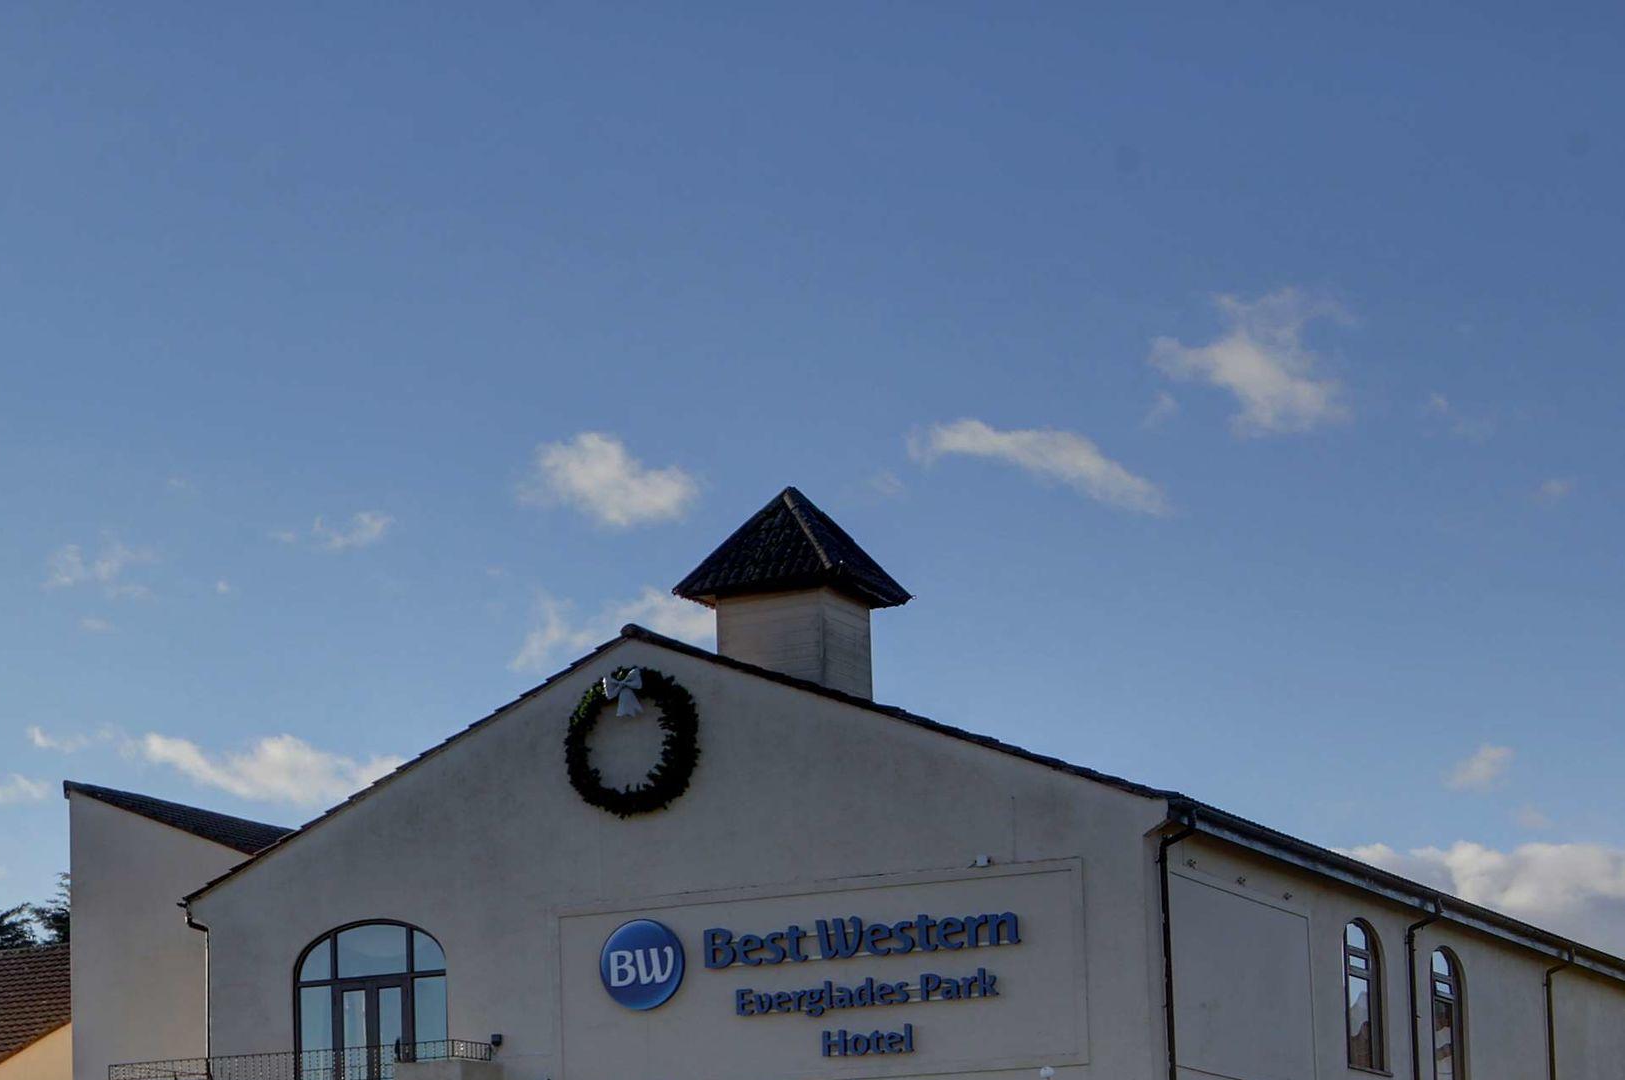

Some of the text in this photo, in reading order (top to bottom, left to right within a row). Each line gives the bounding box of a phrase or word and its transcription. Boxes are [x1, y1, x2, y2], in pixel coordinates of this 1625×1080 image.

[703, 911, 1021, 969] Best Western
[609, 945, 674, 988] BW
[735, 967, 1000, 1017] Everglades Park
[821, 1023, 915, 1057] Hotel
